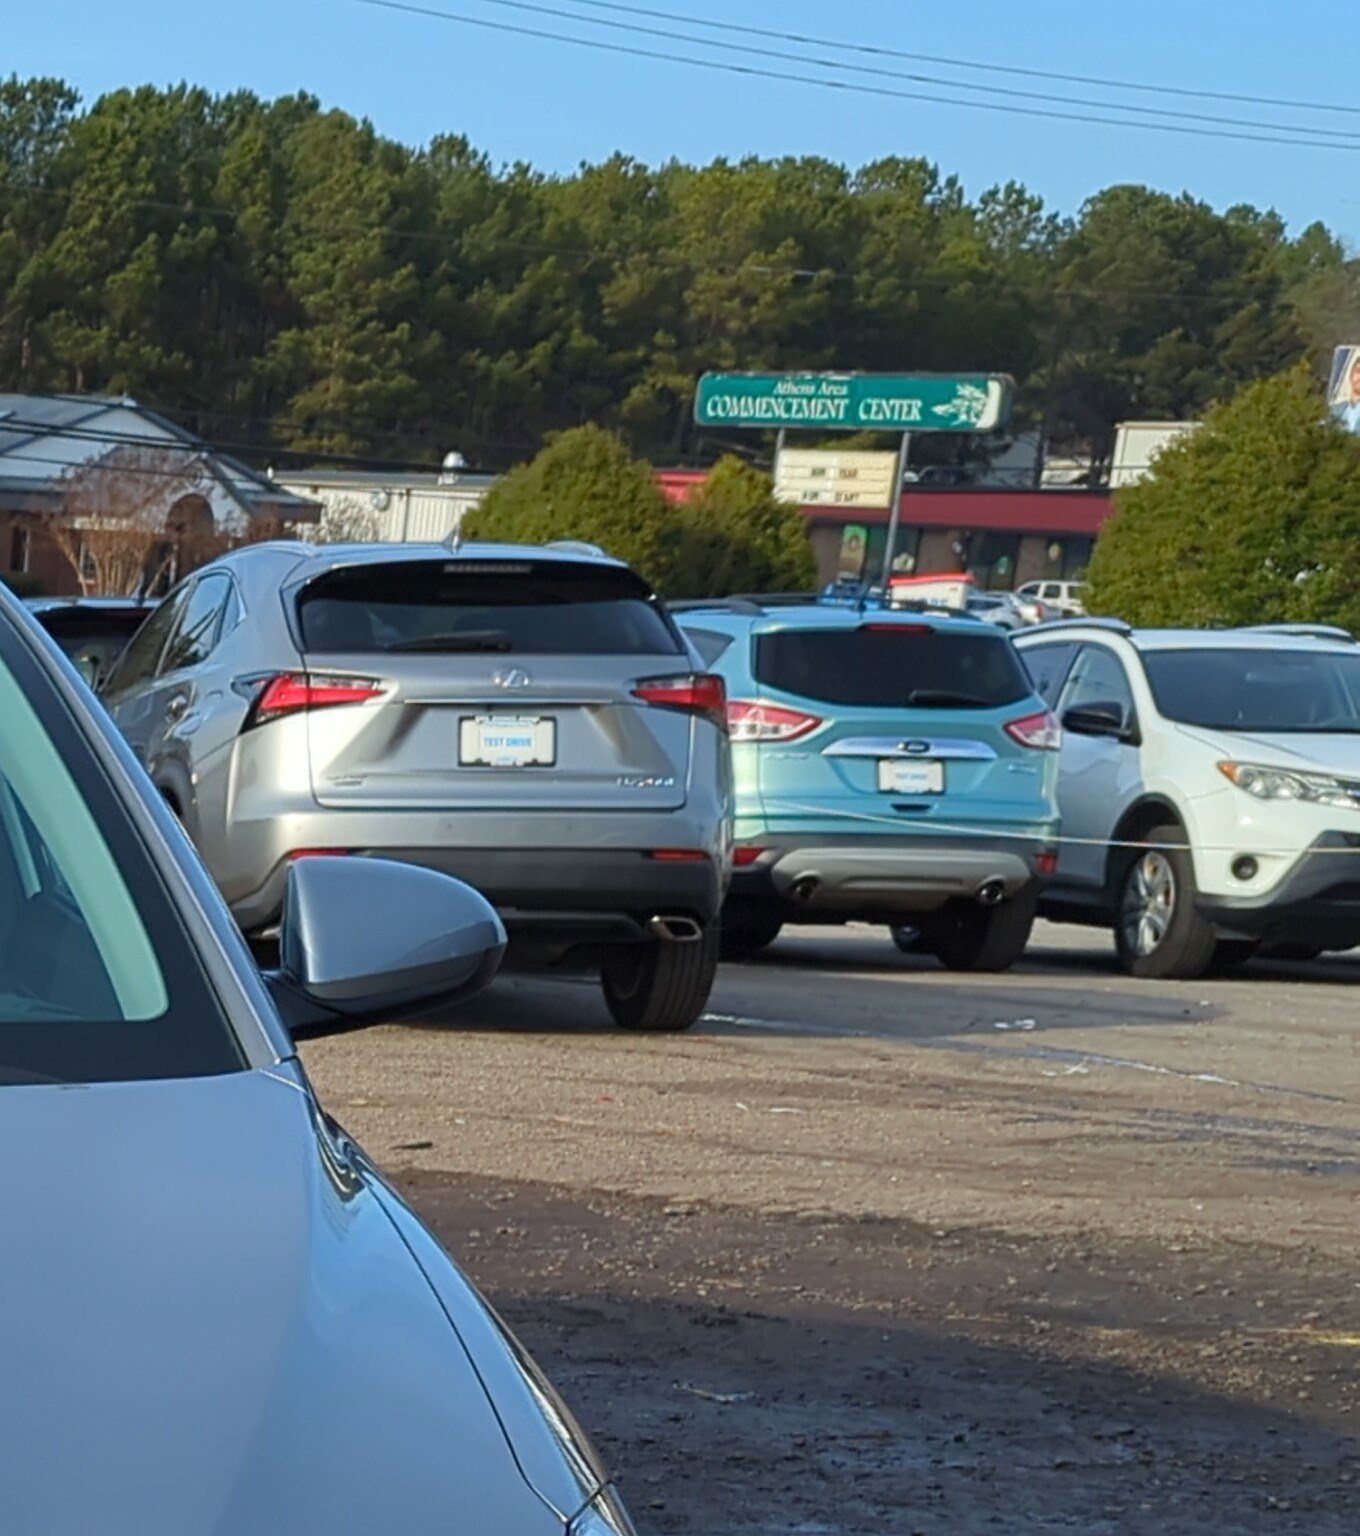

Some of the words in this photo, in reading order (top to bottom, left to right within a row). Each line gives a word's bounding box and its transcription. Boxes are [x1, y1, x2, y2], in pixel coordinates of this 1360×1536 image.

[773, 381, 815, 395] Athens
[819, 382, 848, 395] Area
[706, 395, 849, 420] COMMENCEMENT
[858, 398, 923, 421] CENTER
[484, 737, 503, 747] TEST
[505, 737, 532, 747] DRIVE
